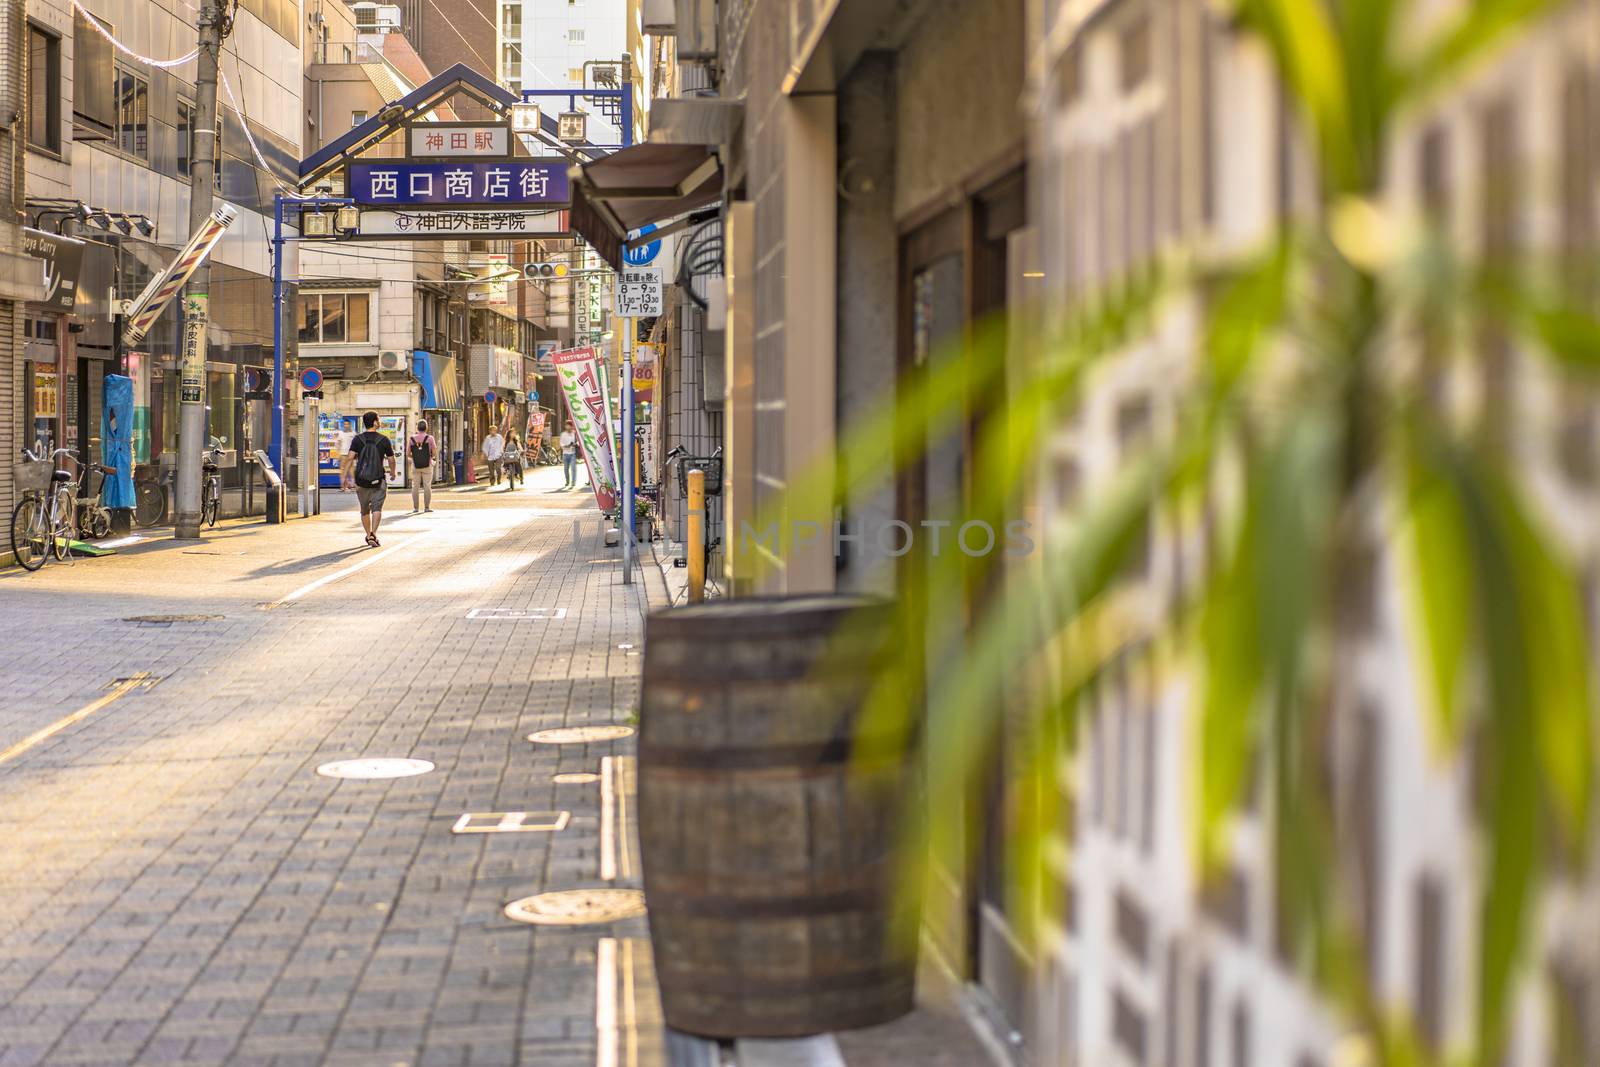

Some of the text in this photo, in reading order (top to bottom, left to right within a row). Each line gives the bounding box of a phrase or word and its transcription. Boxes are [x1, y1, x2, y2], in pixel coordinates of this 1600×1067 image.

[425, 131, 493, 150] 神田駅
[370, 168, 549, 198] 西口商店街
[415, 213, 526, 231] 神田外語学院
[39, 238, 57, 256] Curry
